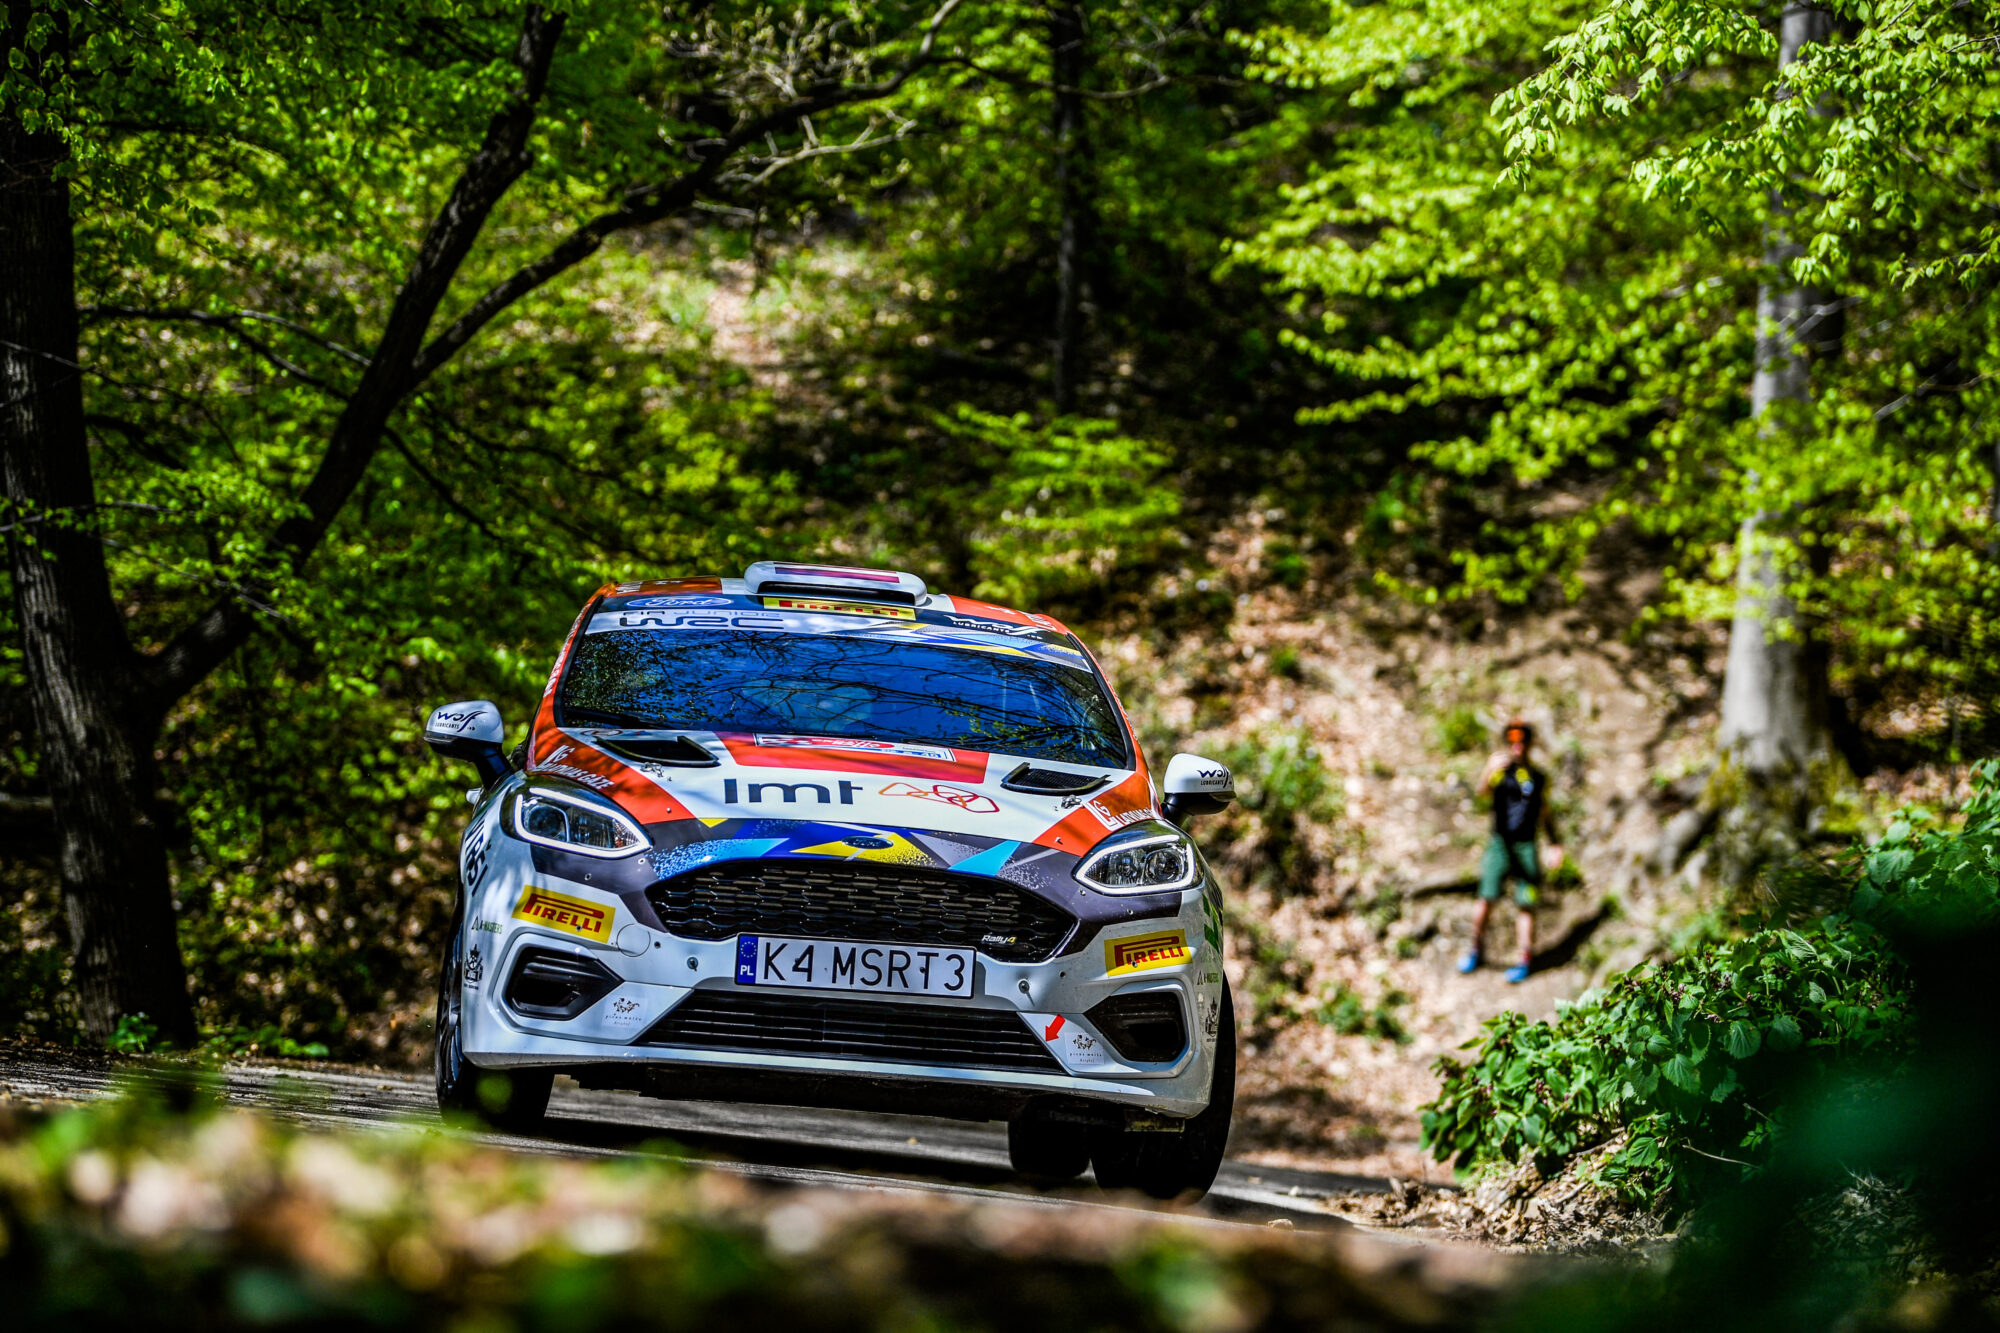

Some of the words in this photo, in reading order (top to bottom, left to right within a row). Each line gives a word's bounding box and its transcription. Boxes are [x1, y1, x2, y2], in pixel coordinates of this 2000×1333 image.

[645, 597, 713, 606] Ford
[620, 616, 784, 630] WRC
[522, 893, 605, 934] PIRELLI
[763, 942, 814, 982] K4
[1114, 935, 1185, 968] PIRELLI
[740, 965, 754, 976] PL
